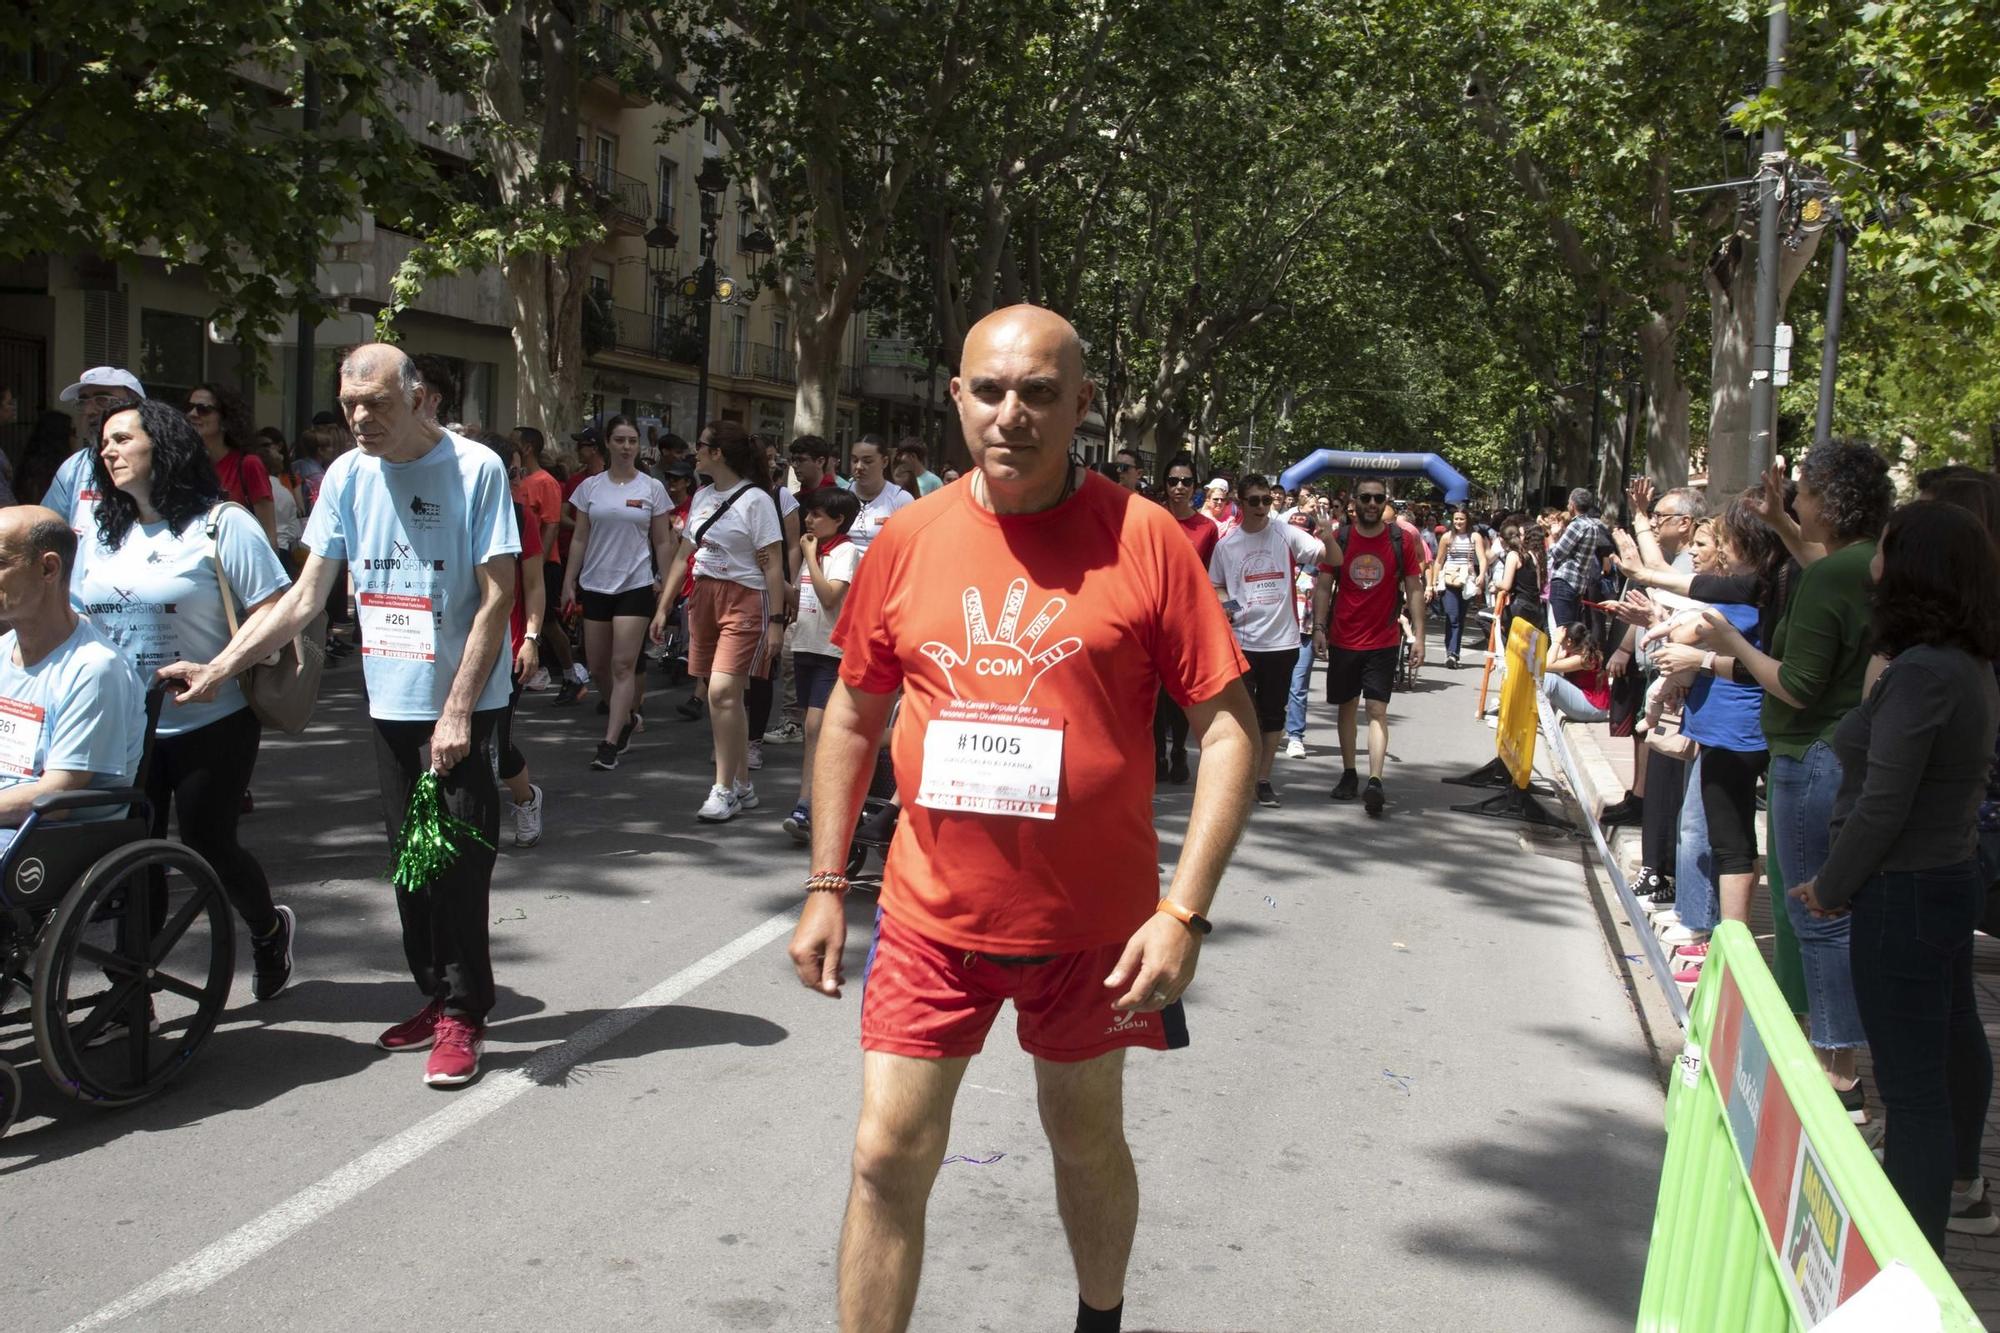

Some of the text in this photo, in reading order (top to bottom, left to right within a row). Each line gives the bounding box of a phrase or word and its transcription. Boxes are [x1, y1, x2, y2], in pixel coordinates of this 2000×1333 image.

[1350, 455, 1400, 471] mychip
[373, 558, 401, 570] GRUPO
[91, 603, 163, 614] GRUPO GASTRO
[385, 613, 410, 626] #261
[1027, 613, 1051, 641] TOTS
[931, 647, 955, 669] JO
[1037, 646, 1064, 666] TU
[975, 658, 1023, 676] COM
[990, 701, 1018, 713] Popular
[1014, 713, 1049, 726] Funcional
[958, 733, 1021, 755] #1005
[1803, 1159, 1838, 1258] MOLINA
